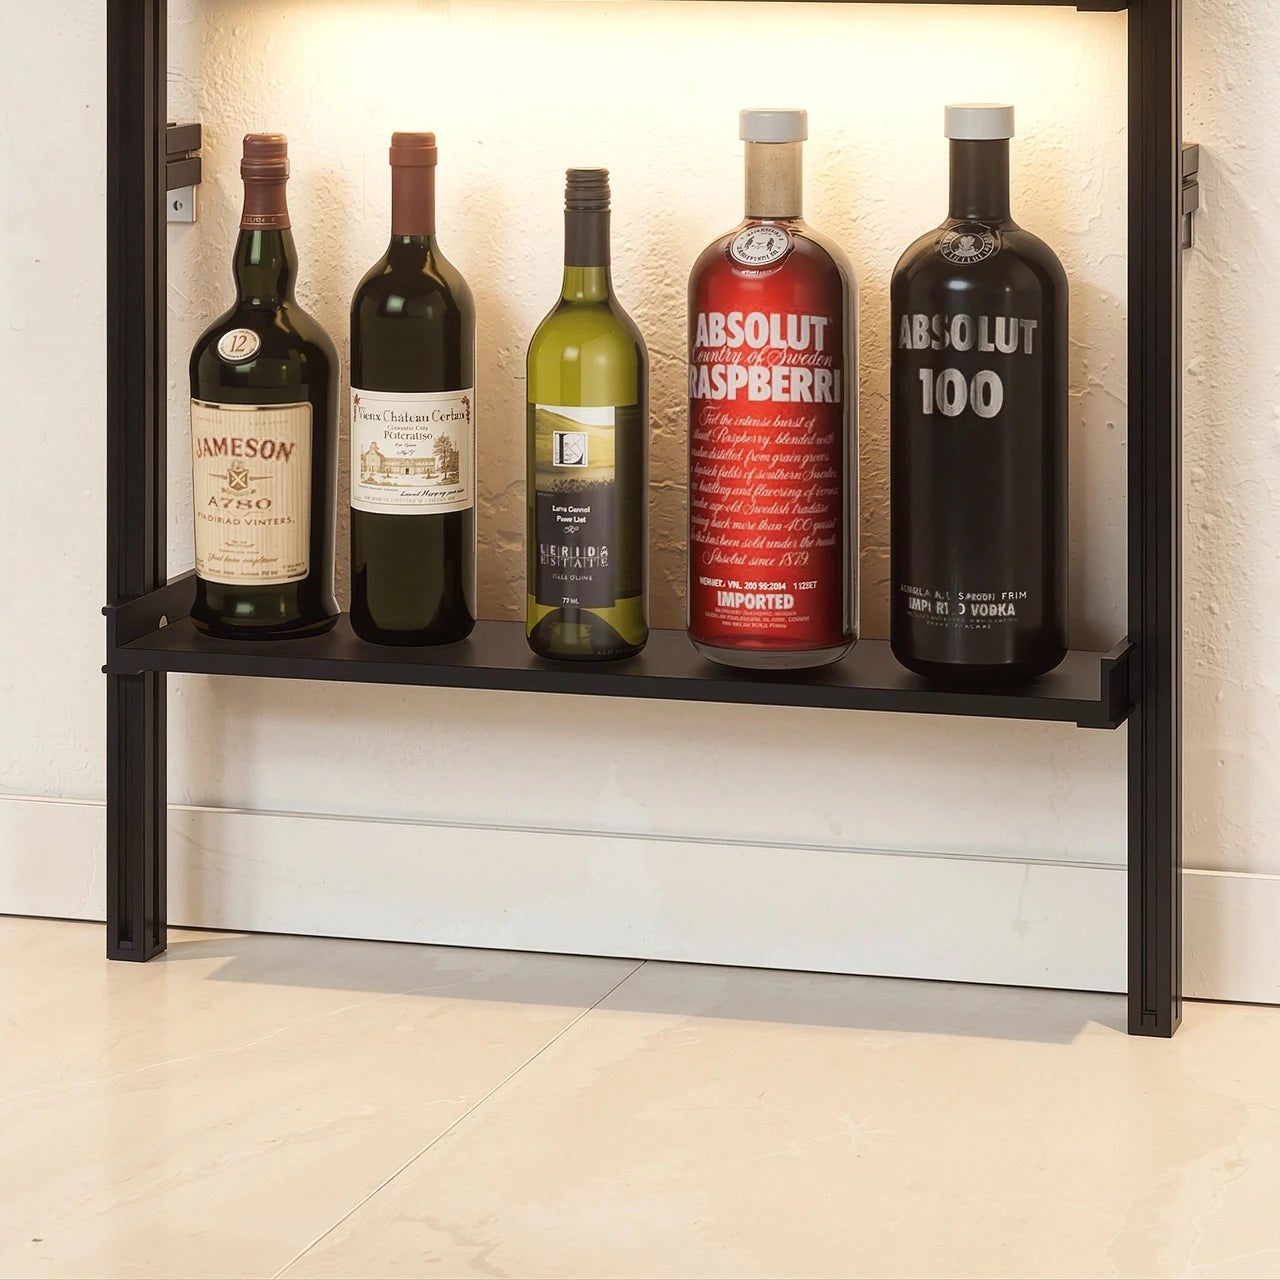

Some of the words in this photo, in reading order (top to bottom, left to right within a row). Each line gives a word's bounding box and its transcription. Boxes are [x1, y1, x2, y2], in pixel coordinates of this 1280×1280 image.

[696, 312, 828, 351] ABSOLUT
[898, 313, 1038, 355] ABSOLUT
[229, 334, 248, 353] 12
[767, 347, 833, 366] Sweden
[689, 365, 840, 403] RASPBERRI
[919, 367, 1004, 419] 100
[197, 437, 294, 463] JAMESON
[744, 447, 769, 466] from
[771, 453, 800, 468] grain
[757, 519, 782, 531] than
[743, 537, 766, 548] sold
[717, 590, 795, 610] IMPORTED
[971, 603, 1016, 617] VODKA
